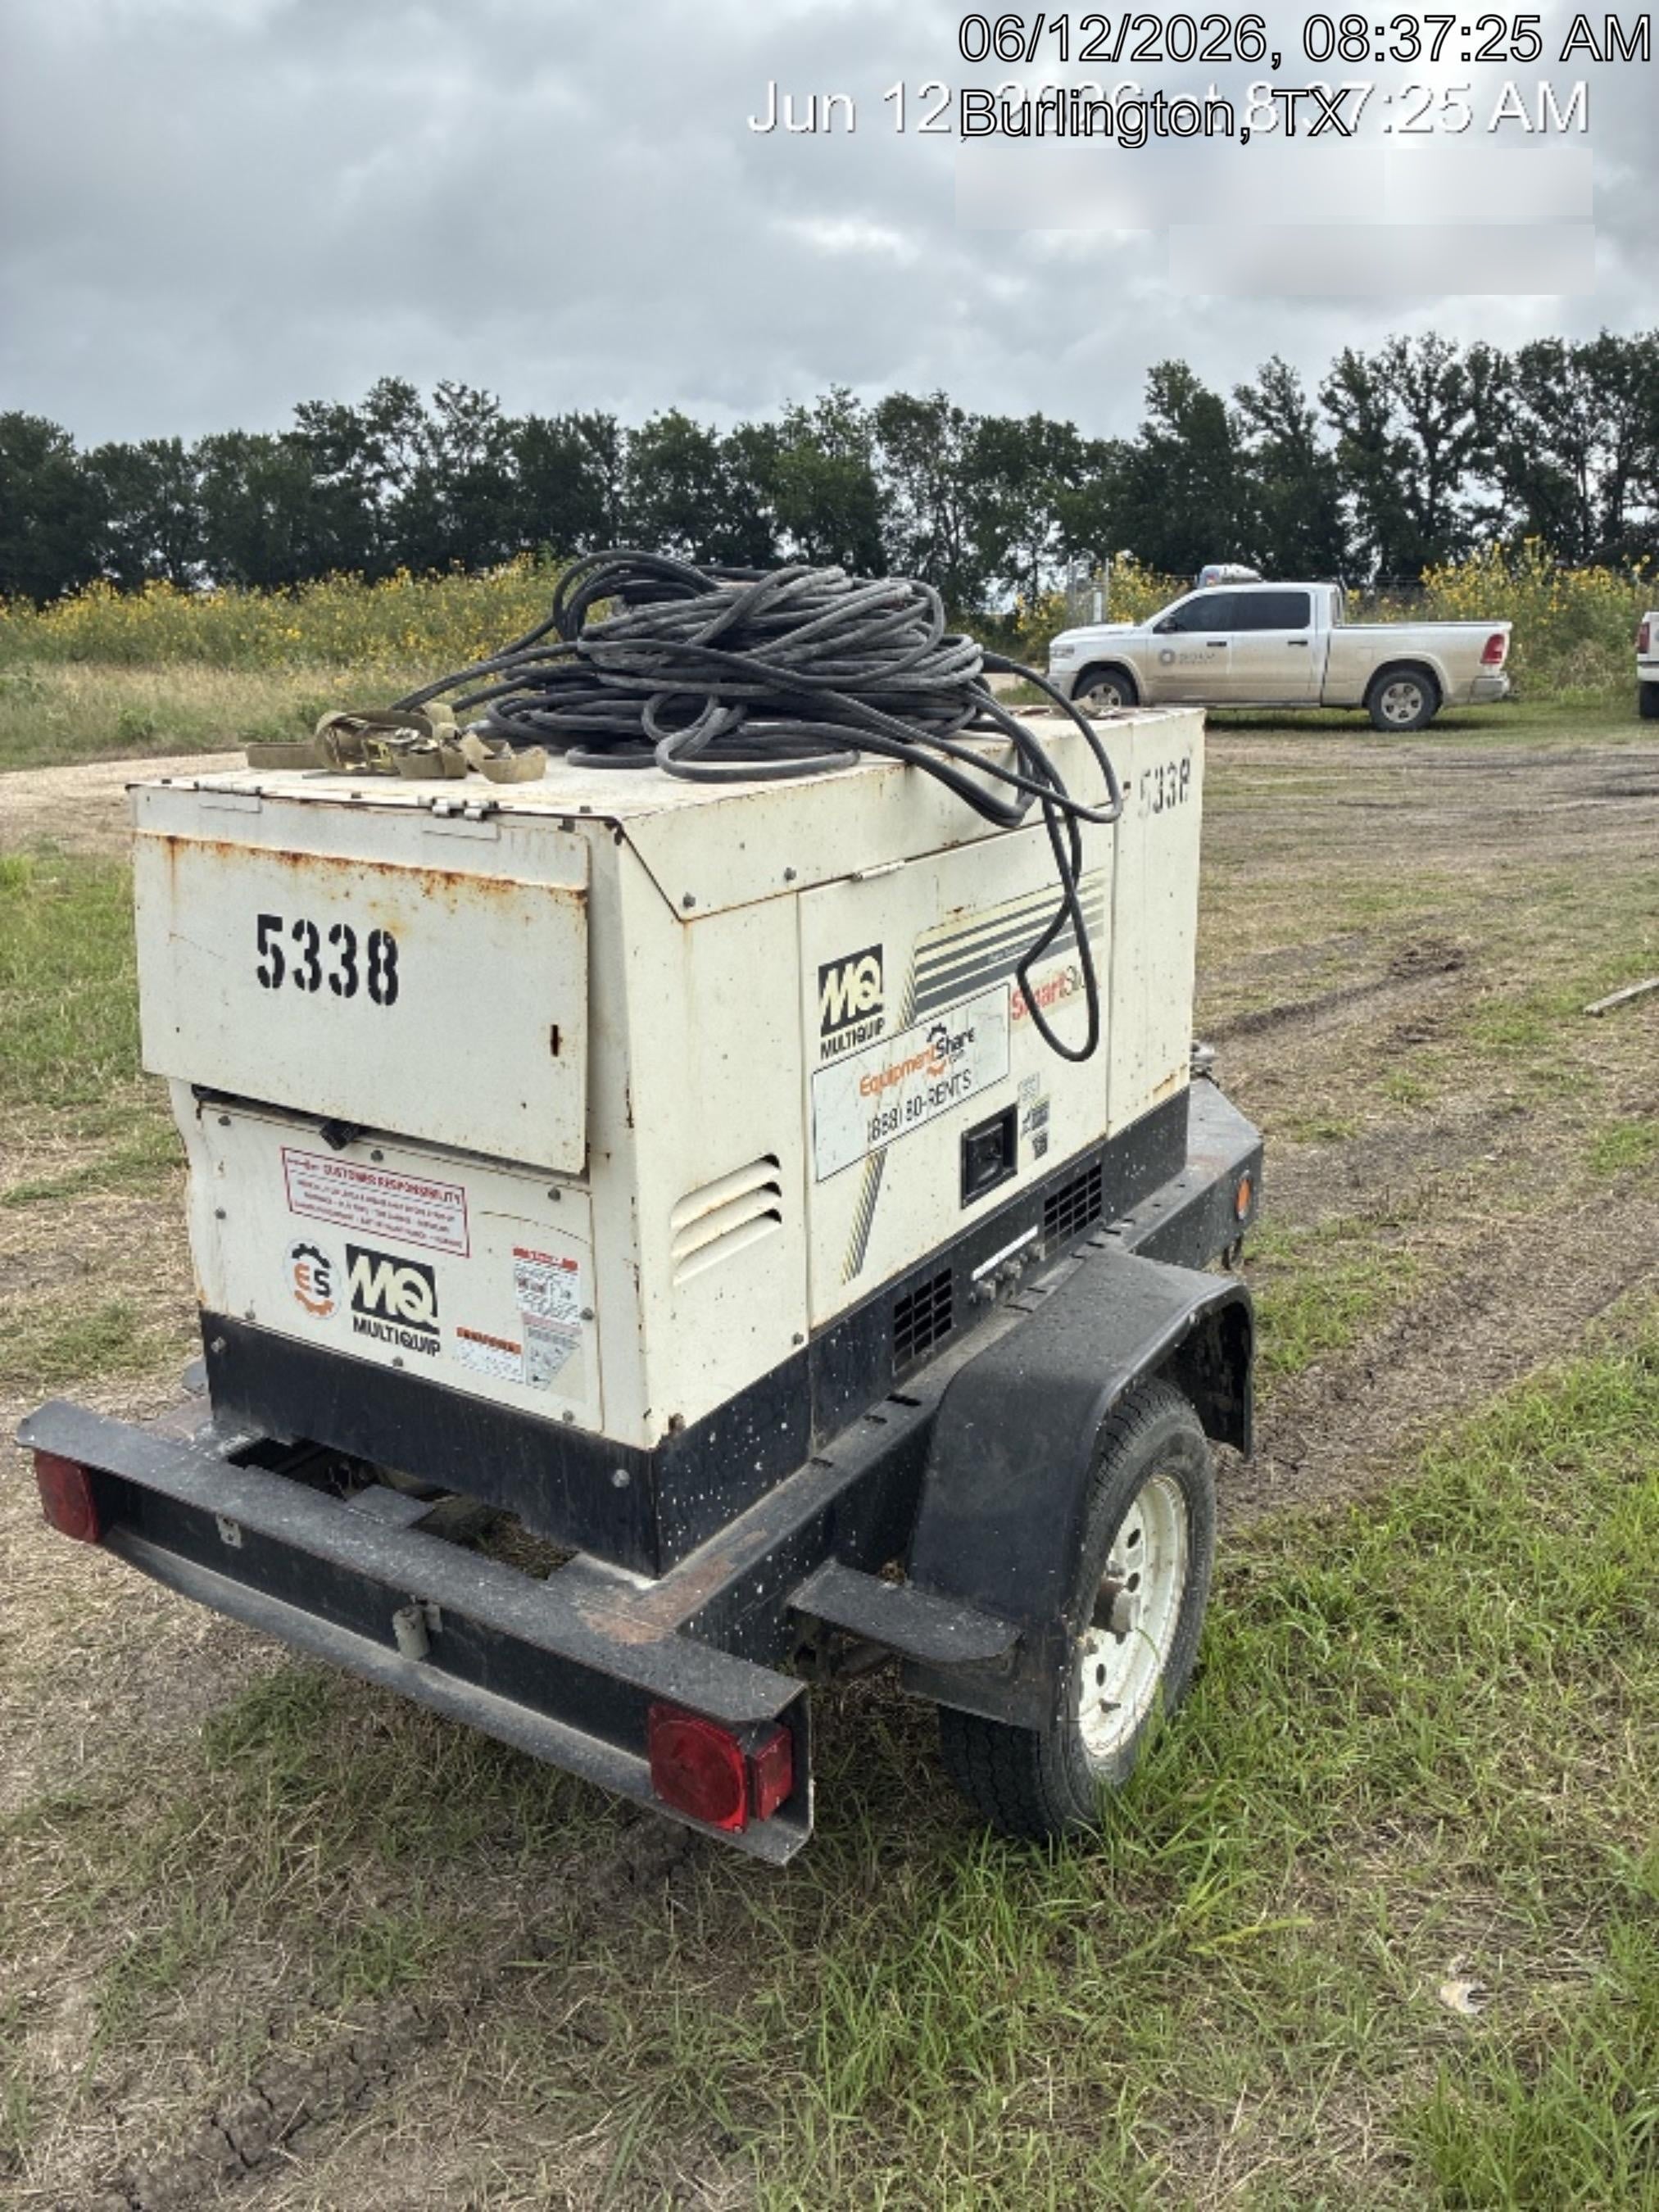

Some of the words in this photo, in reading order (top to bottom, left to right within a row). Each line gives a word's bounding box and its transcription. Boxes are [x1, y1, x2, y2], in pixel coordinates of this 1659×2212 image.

[256, 913, 399, 1006] 5338
[818, 954, 883, 1026] MQ
[820, 1017, 885, 1060] MULTIQUIP
[859, 1026, 975, 1098] EquipmentShare
[348, 1253, 441, 1329] MQ
[352, 1314, 441, 1358] MULTIQUIP
